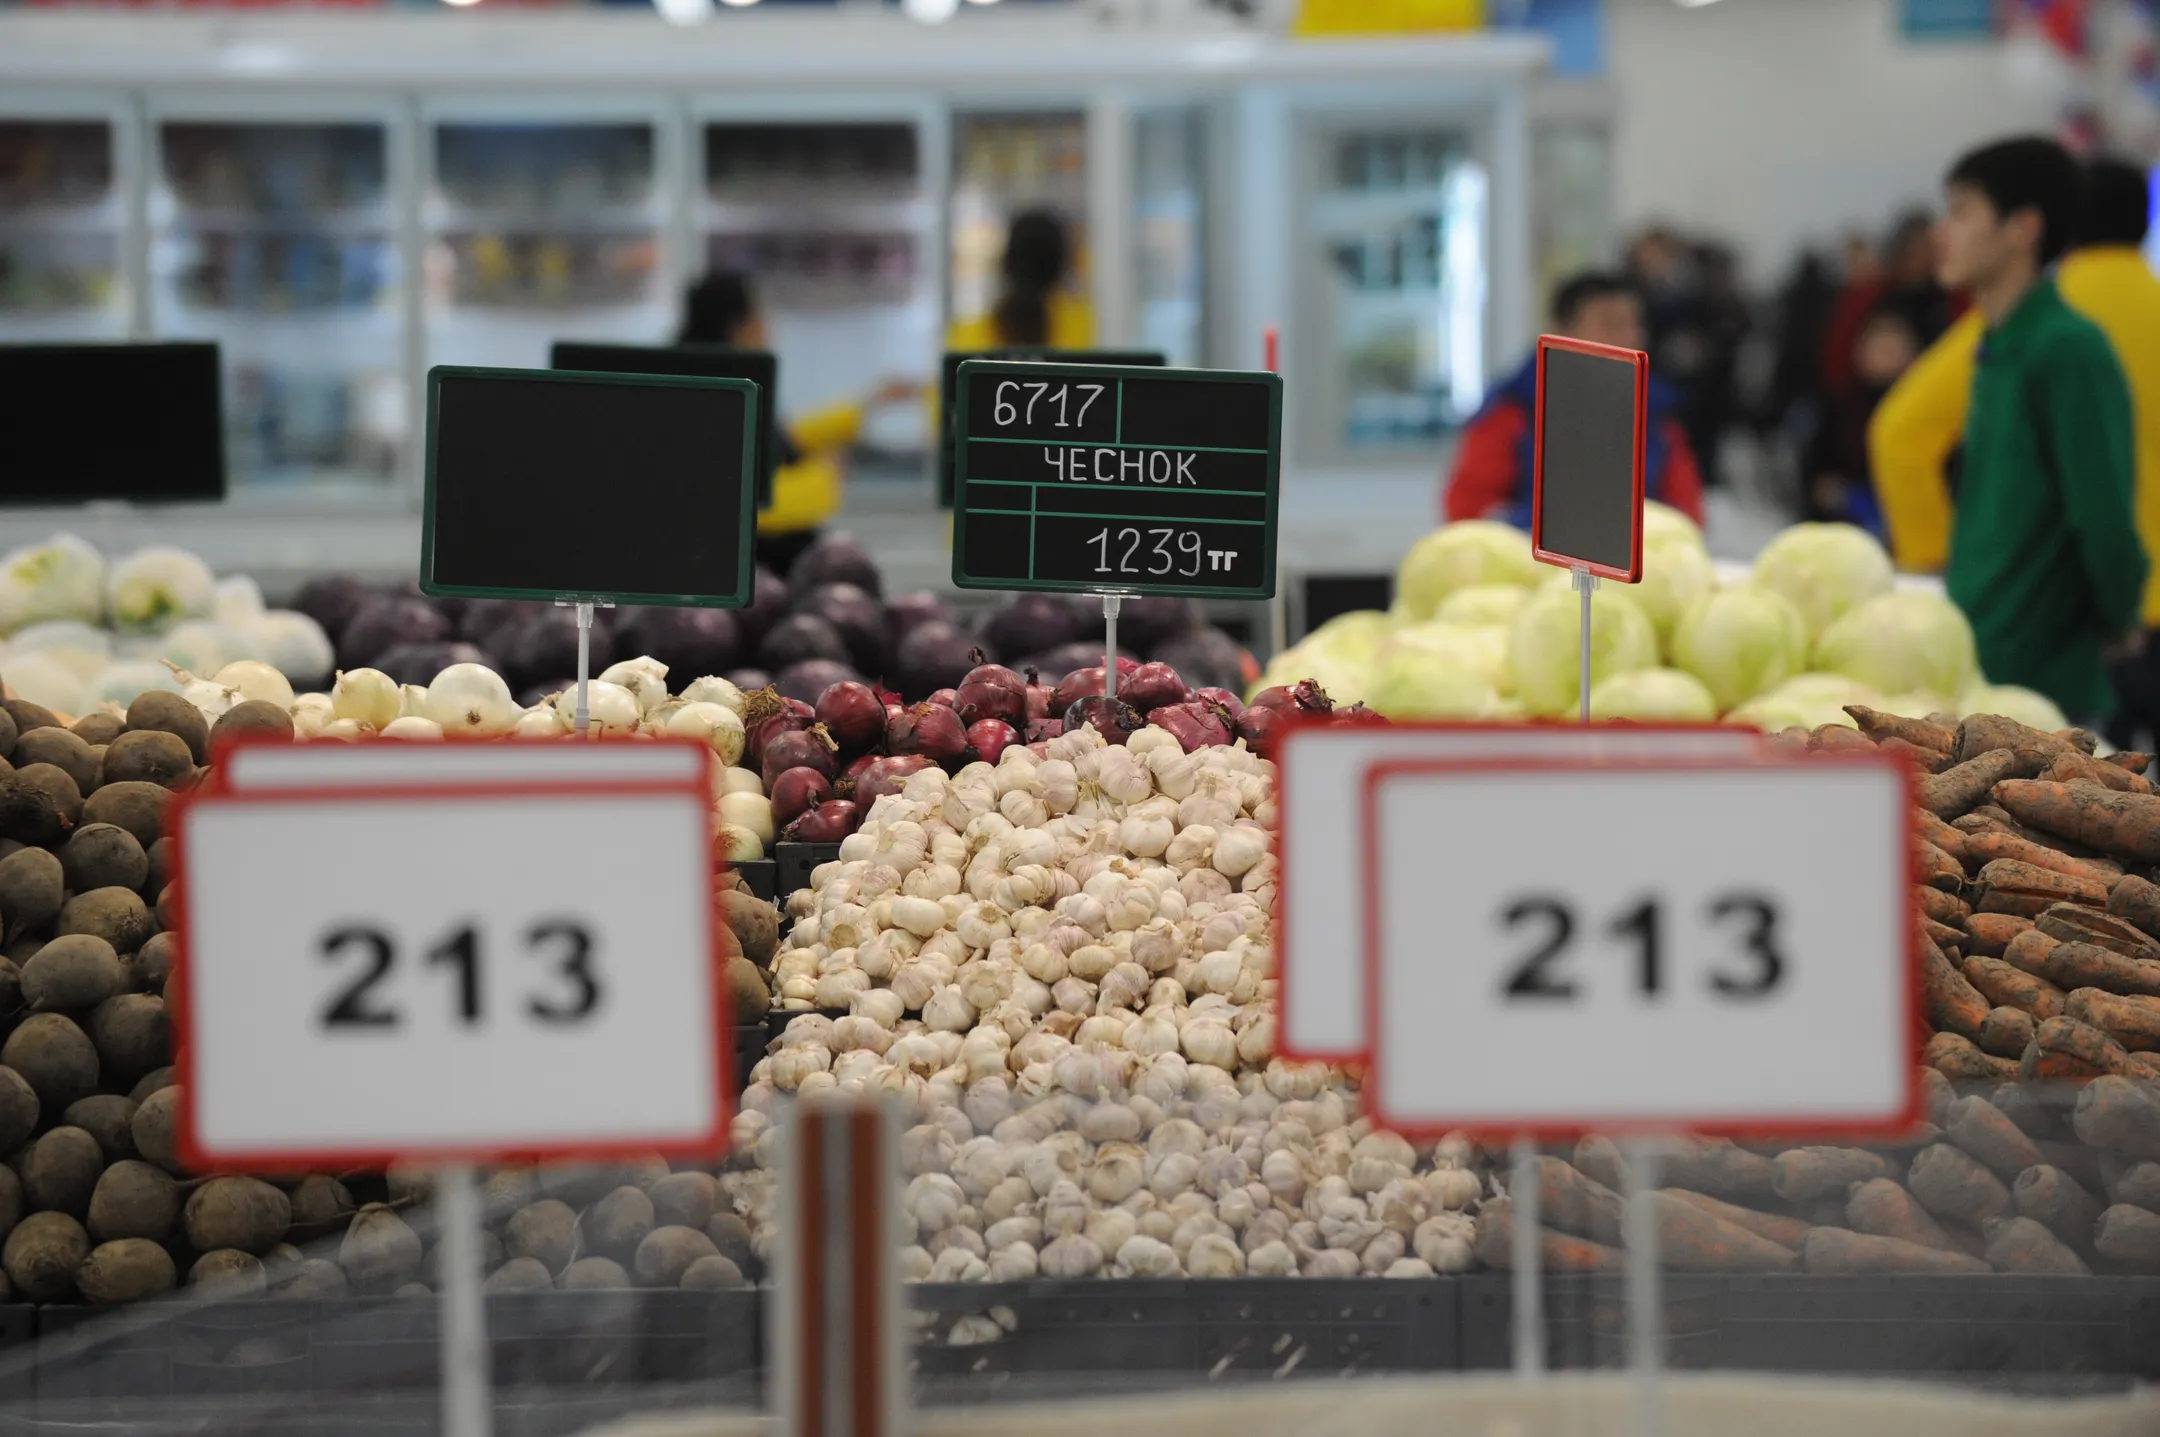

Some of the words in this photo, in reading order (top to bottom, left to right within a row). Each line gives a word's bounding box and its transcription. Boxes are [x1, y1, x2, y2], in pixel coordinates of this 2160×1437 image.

[993, 380, 1105, 428] 6717
[1044, 447, 1197, 485] ЧЕСНОК
[318, 920, 603, 1031] 213
[1500, 894, 1788, 1002] 213
